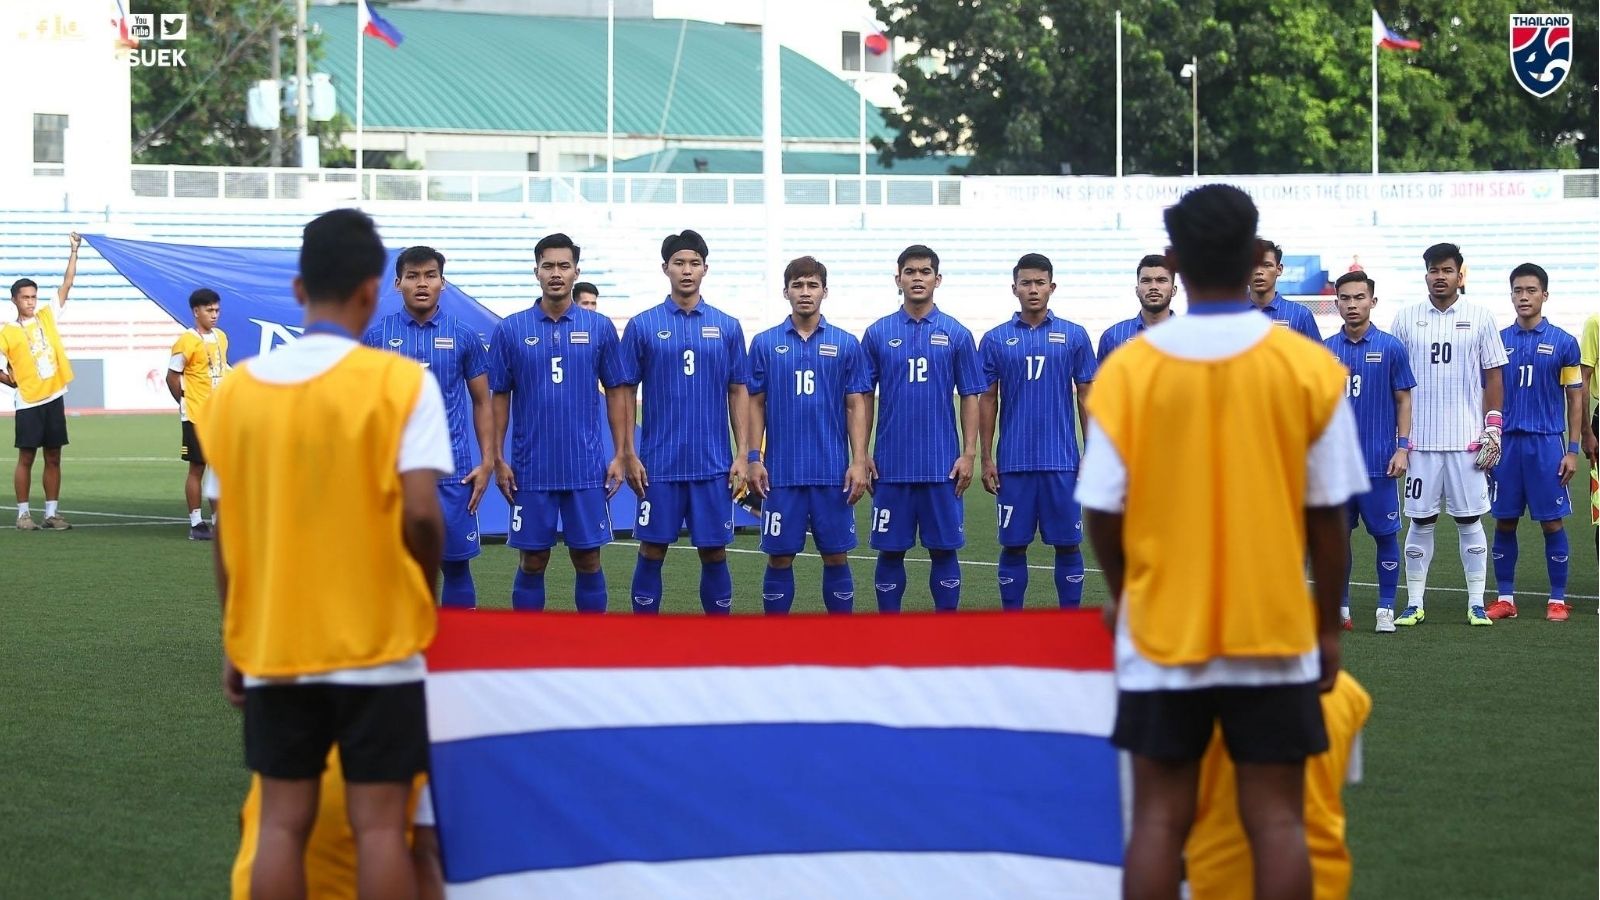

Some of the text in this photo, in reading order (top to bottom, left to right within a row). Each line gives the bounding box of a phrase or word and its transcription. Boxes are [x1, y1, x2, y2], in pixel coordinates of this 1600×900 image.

[1077, 184, 1132, 201] SPORS
[1316, 184, 1341, 200] THE
[1345, 183, 1424, 200] DELGATES
[1428, 183, 1444, 199] OF
[1450, 182, 1484, 199] 30TH
[1489, 181, 1525, 198] SEAG
[683, 349, 696, 377] 3
[1430, 341, 1452, 365] 20
[551, 356, 565, 385] 5
[907, 355, 929, 384] 12
[1025, 354, 1046, 382] 17
[1518, 364, 1534, 388] 11
[794, 369, 815, 396] 16
[1404, 476, 1423, 500] 20
[511, 505, 523, 533] 5
[638, 500, 651, 527] 3
[763, 510, 782, 537] 16
[871, 506, 891, 533] 12
[997, 502, 1014, 529] 17
